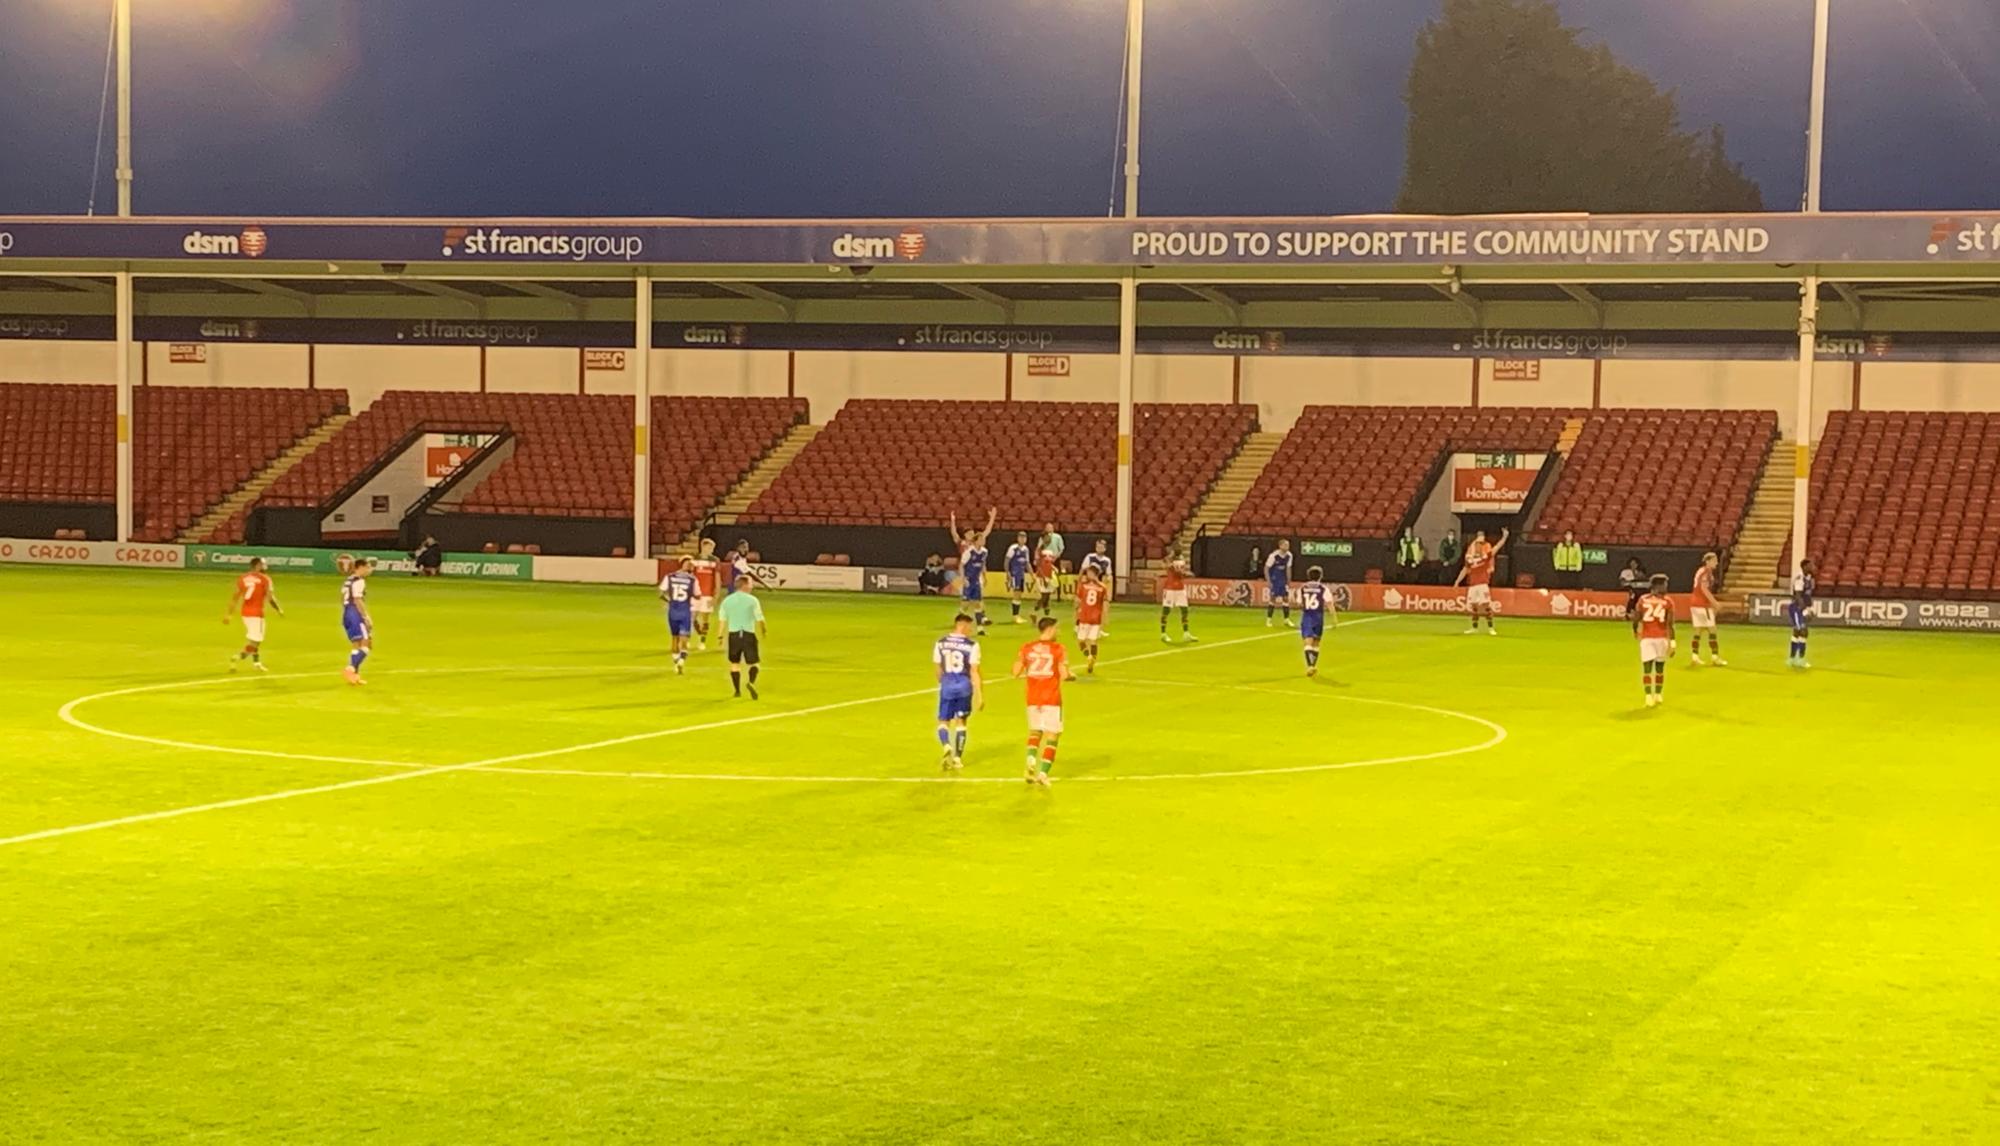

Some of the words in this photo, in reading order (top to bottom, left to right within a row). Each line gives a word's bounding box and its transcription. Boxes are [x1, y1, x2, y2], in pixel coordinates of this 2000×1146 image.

[184, 231, 239, 254] dsm
[833, 233, 894, 258] dsm
[1133, 231, 1228, 256] PROUD
[1233, 232, 1271, 256] TO
[1277, 231, 1408, 256] SUPPORT
[1413, 230, 1467, 255] THE
[1473, 229, 1661, 255] COMMUNITY
[1667, 227, 1770, 253] STAND
[201, 320, 240, 336] dsm
[683, 326, 727, 343] dsm
[1213, 330, 1260, 349] dsm
[612, 352, 625, 368] C
[1057, 358, 1069, 374] D
[1495, 361, 1525, 370] BLOCK
[1527, 361, 1538, 378] E
[1465, 487, 1528, 500] HomeServ
[28, 545, 90, 560] CAZOO
[115, 548, 178, 563] CAZOO
[1315, 543, 1336, 553] FIRST
[1337, 544, 1352, 553] AID
[439, 562, 481, 575] NERGY
[482, 563, 521, 576] DRINK
[671, 583, 689, 602] 15
[1086, 589, 1098, 606] 8
[1303, 593, 1320, 610] 16
[1642, 602, 1666, 622] 24
[1919, 603, 1990, 618] 01922
[940, 649, 964, 673] 18
[1026, 652, 1054, 678] 22
